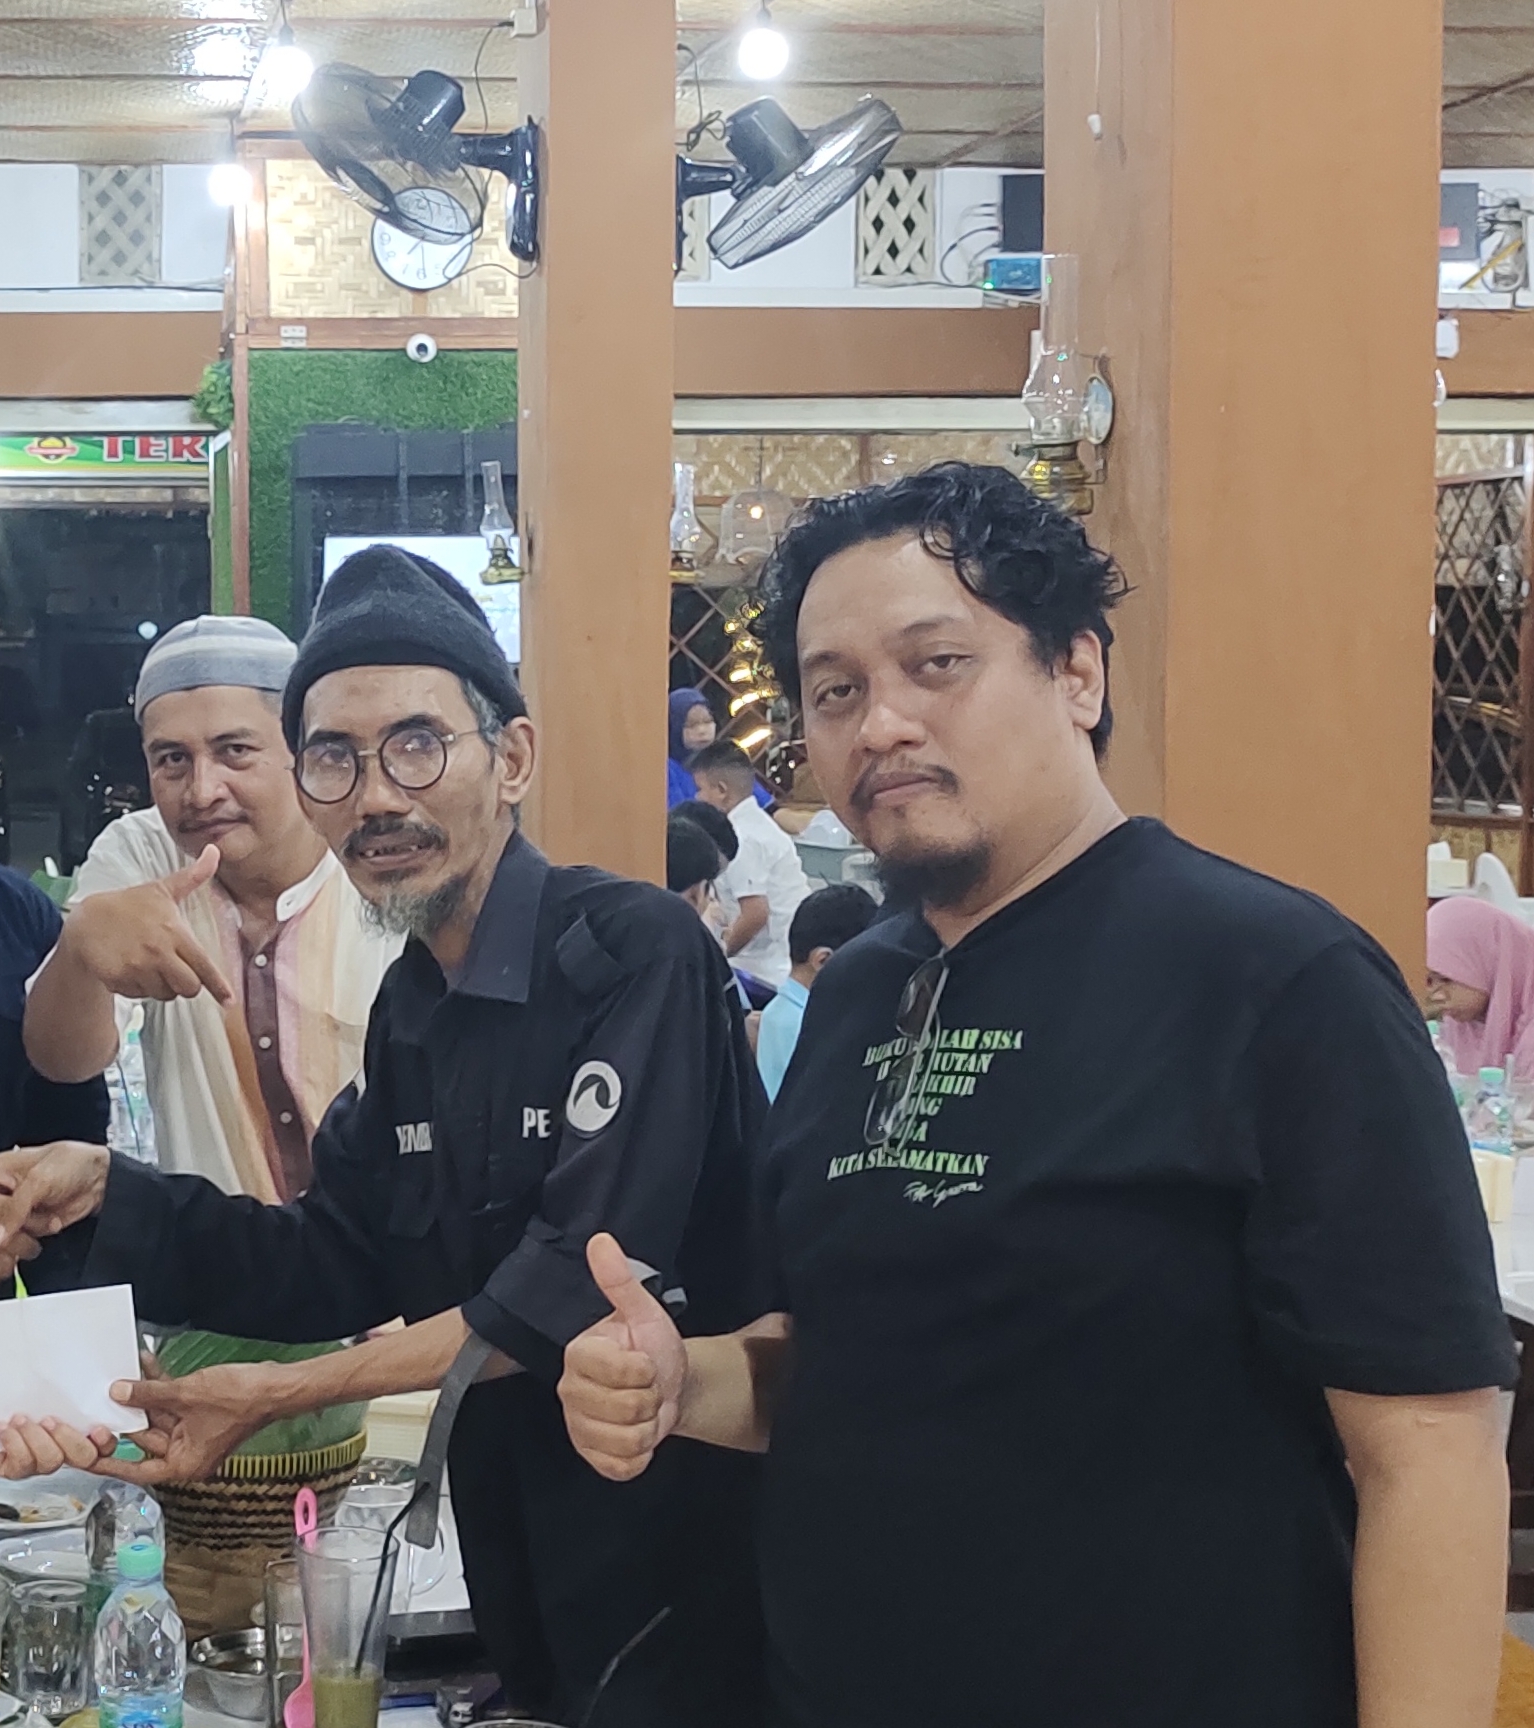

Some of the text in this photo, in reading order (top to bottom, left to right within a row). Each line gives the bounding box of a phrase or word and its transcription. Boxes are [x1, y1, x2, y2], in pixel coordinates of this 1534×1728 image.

[979, 1030, 1024, 1050] SISA
[522, 1107, 551, 1138] PE
[827, 1152, 865, 1181] KITA
